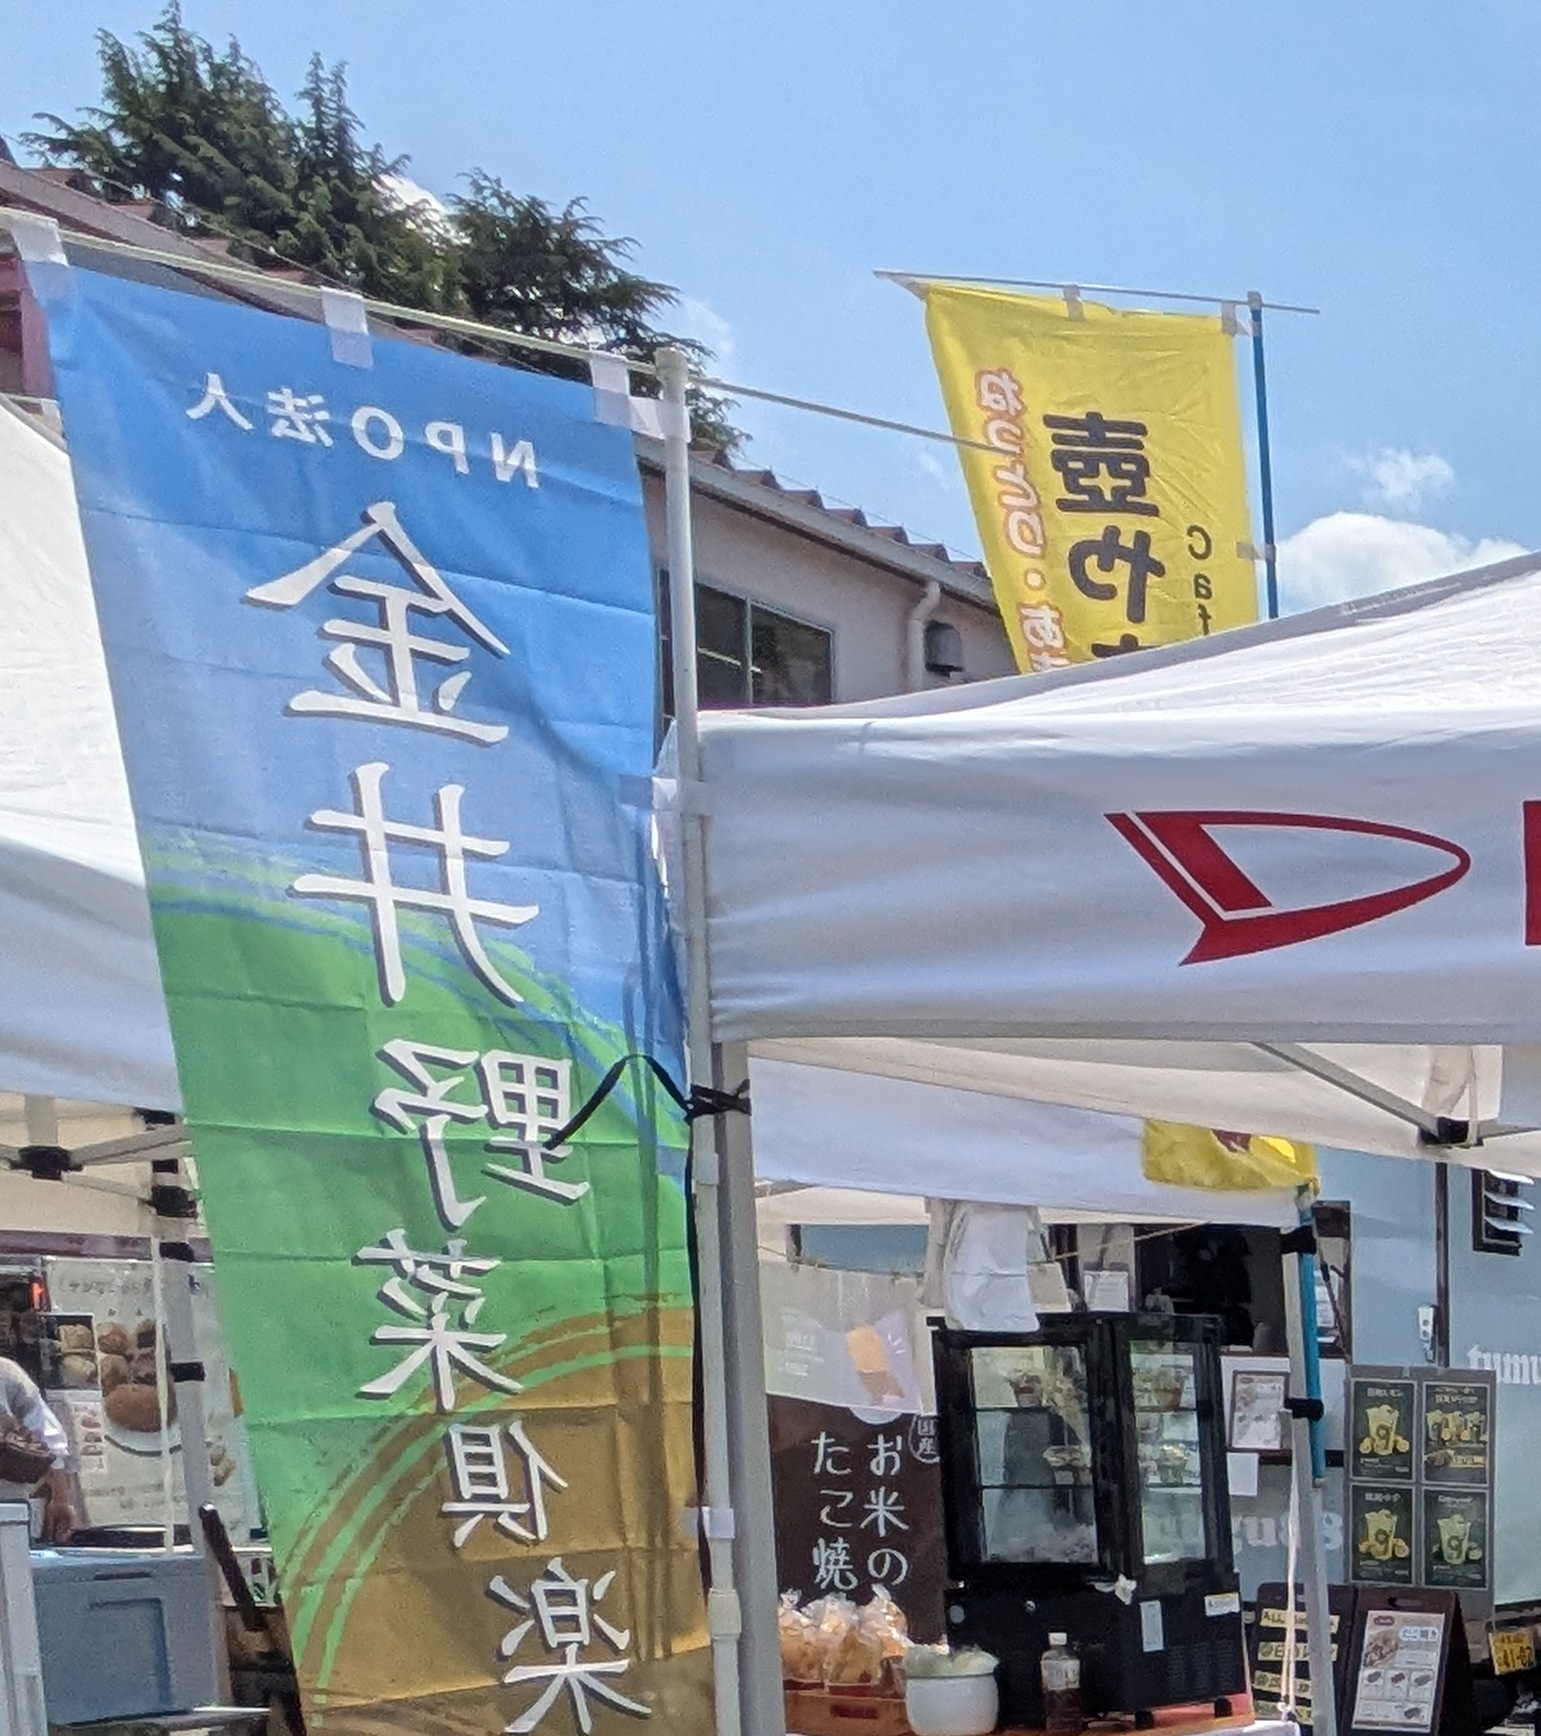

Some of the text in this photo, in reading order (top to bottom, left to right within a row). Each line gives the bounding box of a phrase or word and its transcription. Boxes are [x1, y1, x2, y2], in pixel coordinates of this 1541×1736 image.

[811, 1431, 858, 1590] たこ焼
[859, 1433, 909, 1586] お米の
